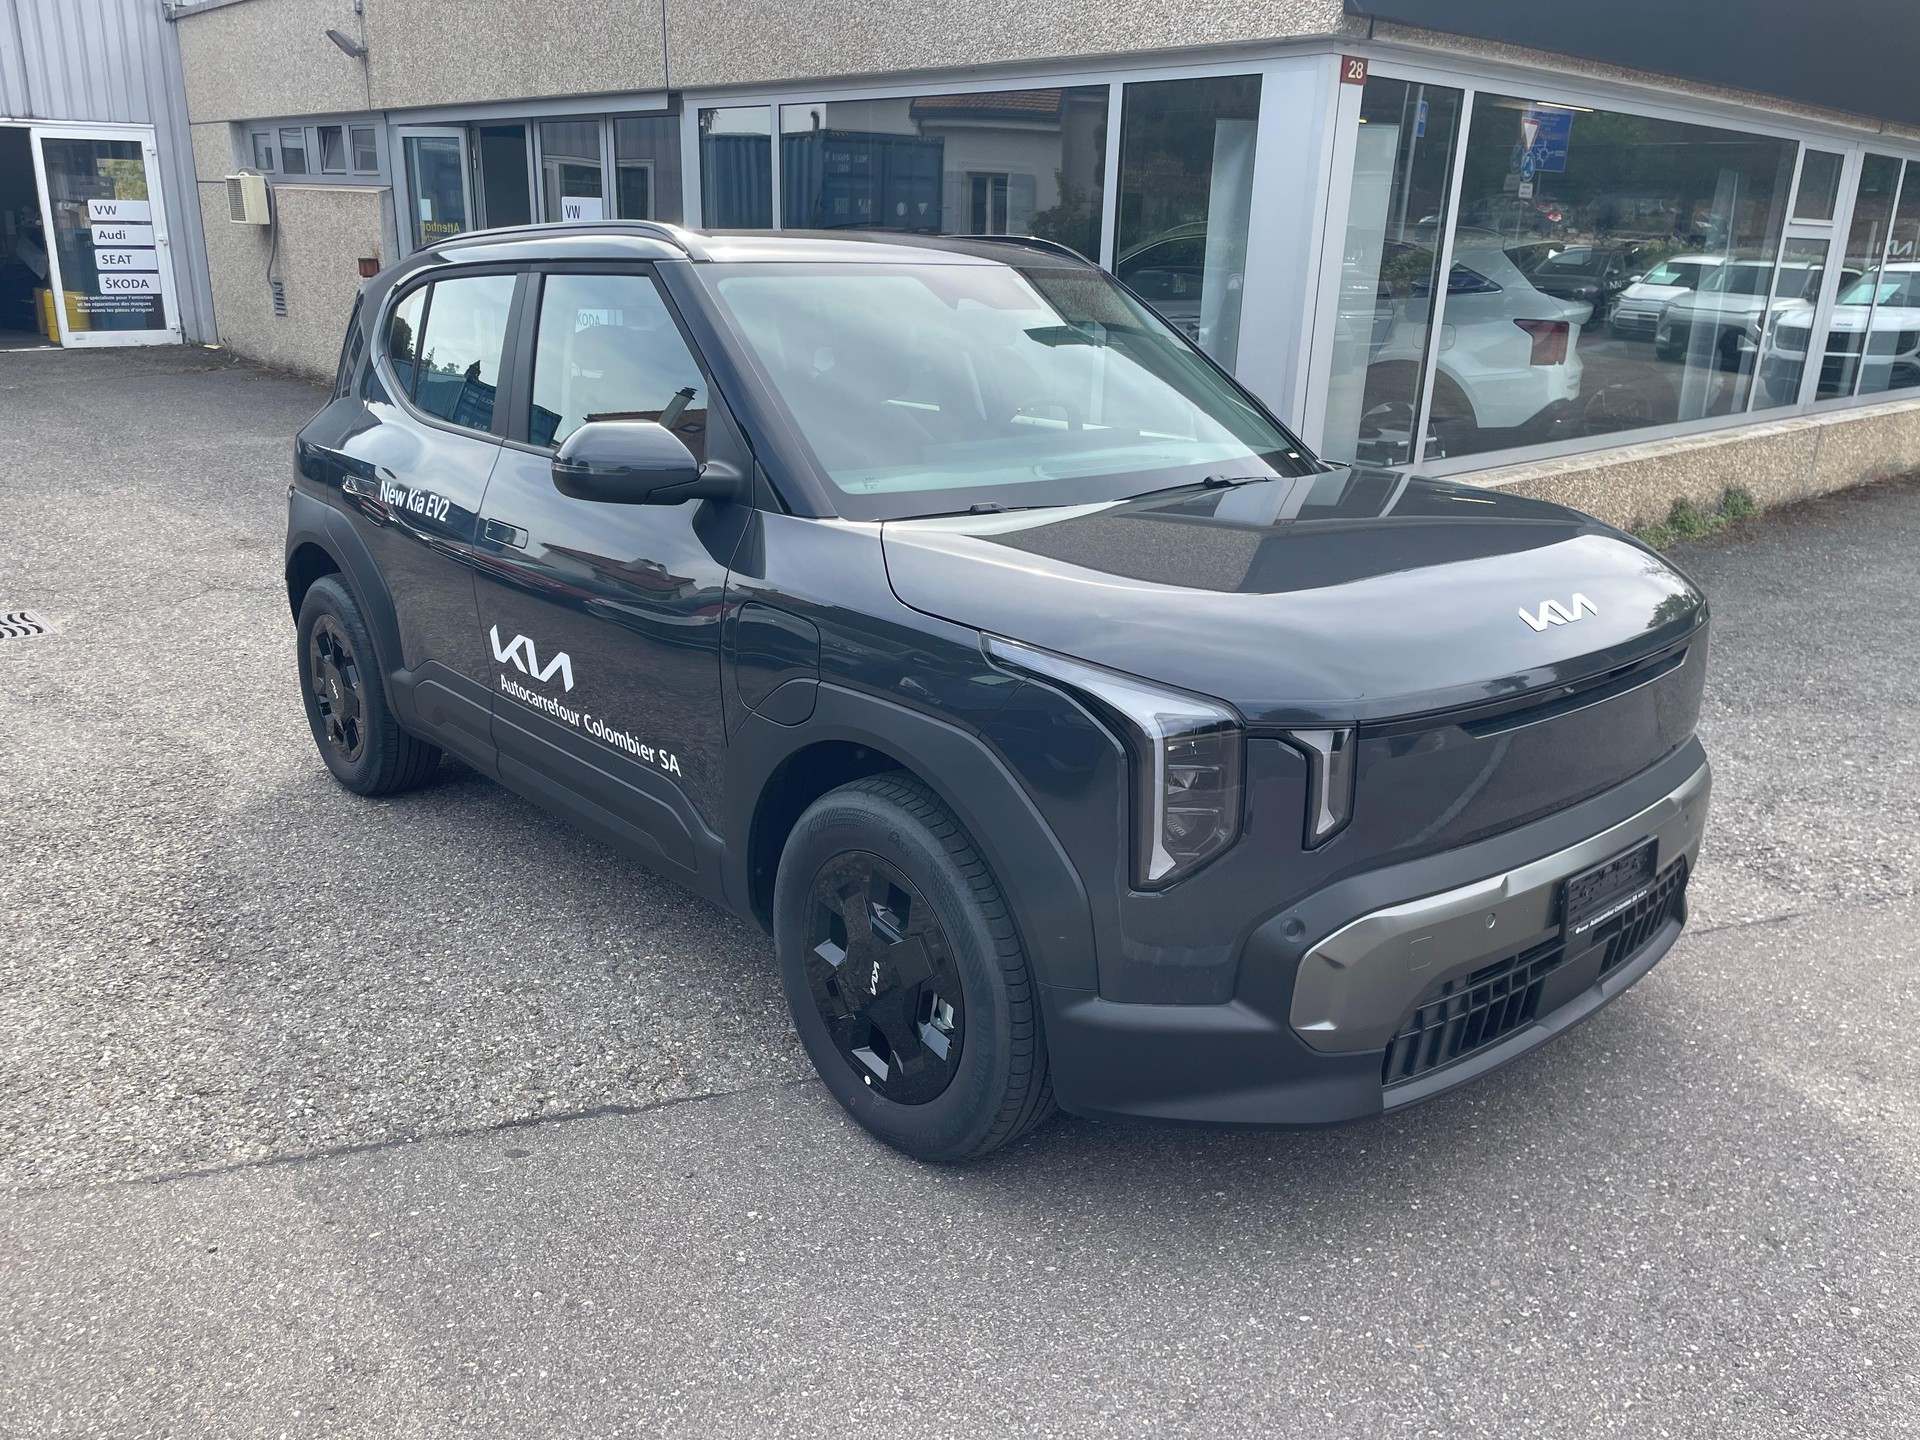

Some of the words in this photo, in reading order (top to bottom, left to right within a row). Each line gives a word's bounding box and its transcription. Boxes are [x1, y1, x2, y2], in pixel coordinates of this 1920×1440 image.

[1348, 60, 1364, 79] 28
[94, 205, 117, 215] VW
[565, 205, 581, 219] VW
[98, 230, 126, 240] Audi
[102, 254, 132, 265] SEAT
[105, 277, 150, 289] ŠKODA
[577, 312, 601, 327] KODA
[380, 480, 406, 507] New
[406, 488, 425, 514] Kia
[425, 494, 450, 522] EV2
[1518, 592, 1598, 633] KIA
[489, 624, 574, 693] KIA
[500, 673, 580, 727] Autocarrefour
[583, 714, 655, 763] Colombier
[659, 748, 682, 777] SA
